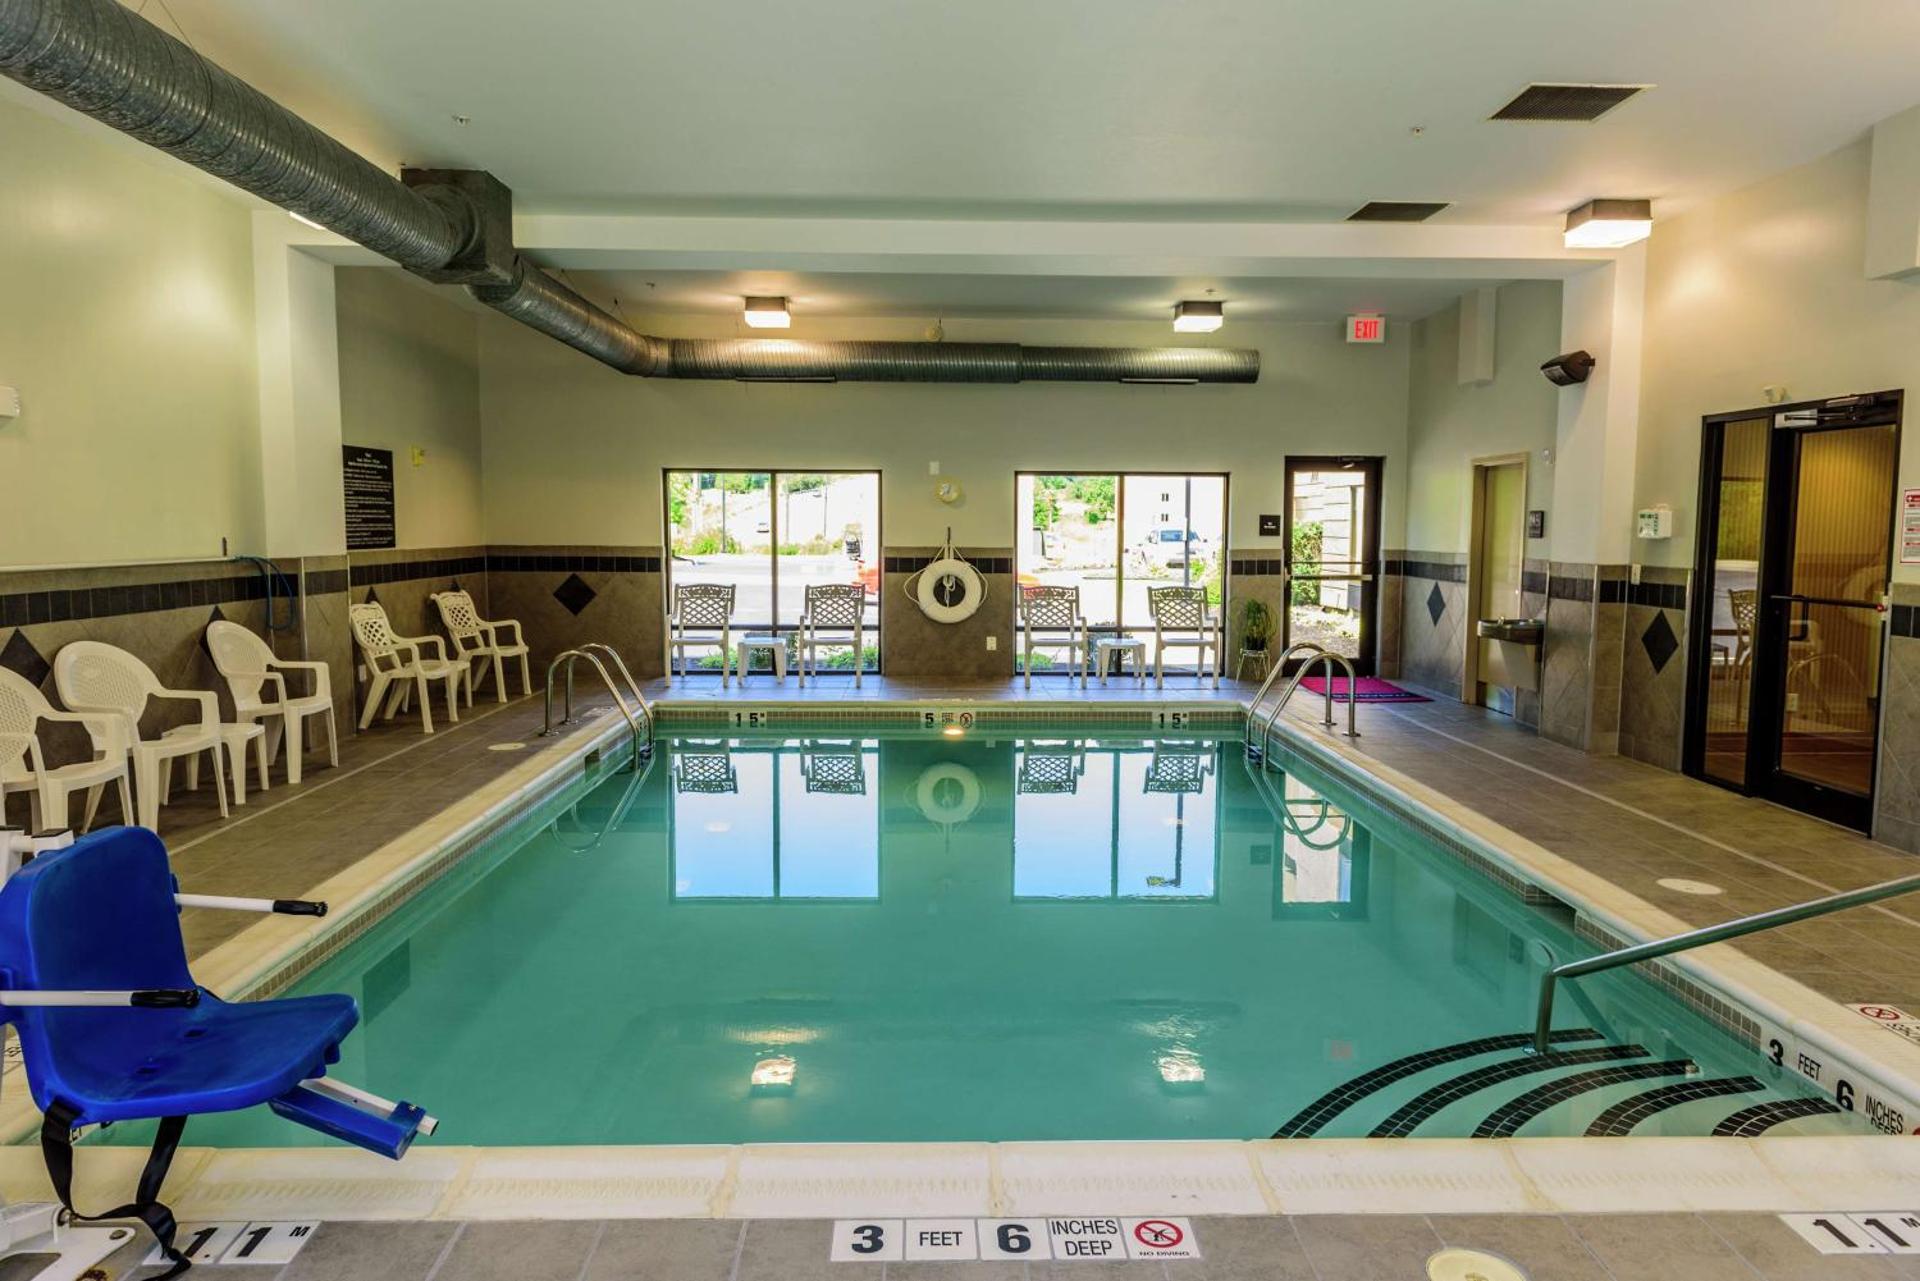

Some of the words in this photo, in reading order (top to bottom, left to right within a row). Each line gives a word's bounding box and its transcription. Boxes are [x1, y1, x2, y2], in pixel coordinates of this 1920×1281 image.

[1354, 319, 1379, 339] EXIT
[1768, 1039, 1784, 1066] 3
[1798, 1052, 1822, 1081] FEET
[1836, 1079, 1854, 1111] 6
[1865, 1094, 1904, 1135] INCHES
[1051, 1220, 1118, 1235] INCHES
[851, 1225, 884, 1253] 3
[919, 1231, 963, 1246] FEET
[997, 1224, 1031, 1253] 6
[1064, 1240, 1112, 1256] DEEP
